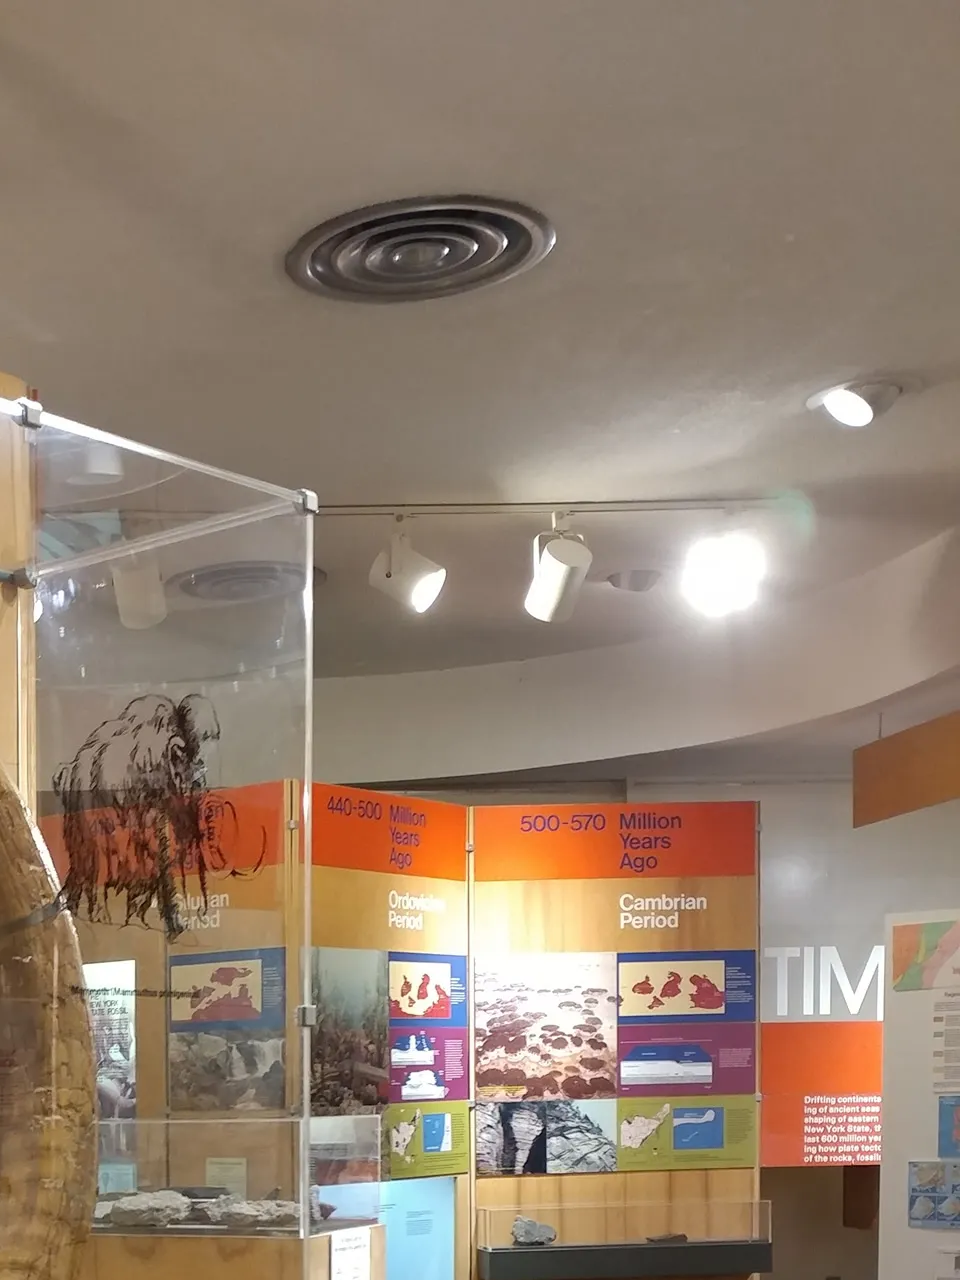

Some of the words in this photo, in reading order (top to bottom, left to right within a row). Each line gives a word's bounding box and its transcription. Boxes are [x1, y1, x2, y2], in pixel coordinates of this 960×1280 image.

[327, 796, 382, 820] 440-500
[390, 804, 426, 827] Million
[520, 814, 606, 832] 500-570
[619, 812, 682, 830] Million
[389, 827, 420, 847] Years
[619, 833, 671, 849] Years
[390, 848, 412, 869] Ago
[619, 853, 658, 873] Ago
[619, 893, 707, 911] Cambrian
[388, 910, 423, 930] Period
[619, 912, 679, 929] Period
[764, 945, 885, 1021] TIM
[804, 1096, 836, 1105] Drifting
[804, 1106, 817, 1115] ing
[829, 1105, 859, 1113] ancient
[804, 1116, 836, 1125] shaping
[837, 1115, 846, 1123] of
[847, 1115, 879, 1123] eastern
[804, 1125, 824, 1133] New
[825, 1125, 845, 1133] York
[804, 1135, 820, 1143] last
[821, 1135, 838, 1143] 600
[839, 1134, 867, 1142] million
[804, 1145, 817, 1154] ing
[838, 1144, 859, 1153] plate
